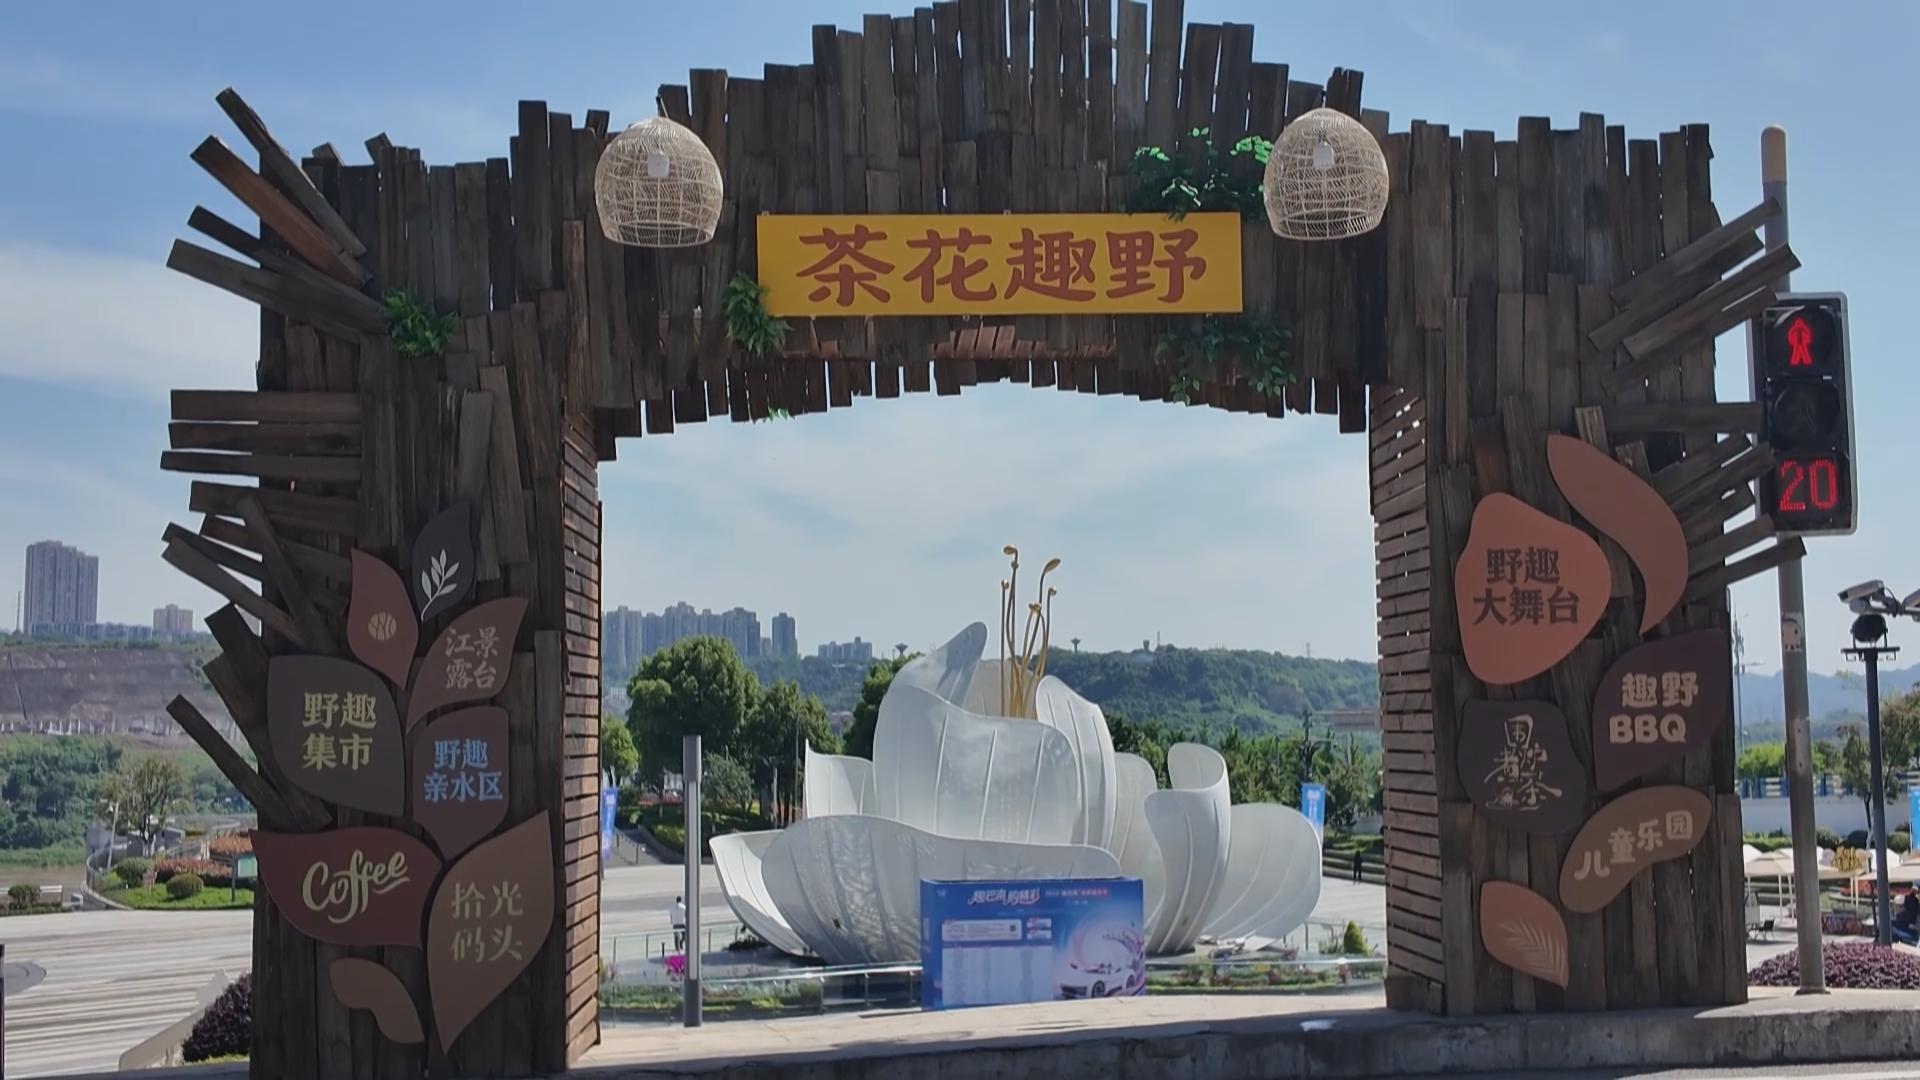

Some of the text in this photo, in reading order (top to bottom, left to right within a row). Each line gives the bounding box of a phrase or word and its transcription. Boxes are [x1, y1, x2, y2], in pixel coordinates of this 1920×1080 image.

[796, 224, 1207, 306] 茶花趣野
[1780, 459, 1839, 511] 20
[1486, 546, 1560, 584] 野趣
[1472, 586, 1580, 625] 大舞台
[445, 626, 500, 658] 江景
[445, 658, 497, 689] 露台
[1622, 672, 1699, 708] 趣野
[302, 691, 377, 729] 野趣
[1609, 713, 1687, 744] BBQ
[302, 732, 373, 771] 集市
[434, 738, 489, 769] 野趣
[424, 771, 503, 803] 亲水区
[1574, 810, 1693, 881] 儿童乐园
[302, 849, 410, 924] Coffee
[451, 880, 524, 919] 拾光
[451, 924, 524, 963] 码头
